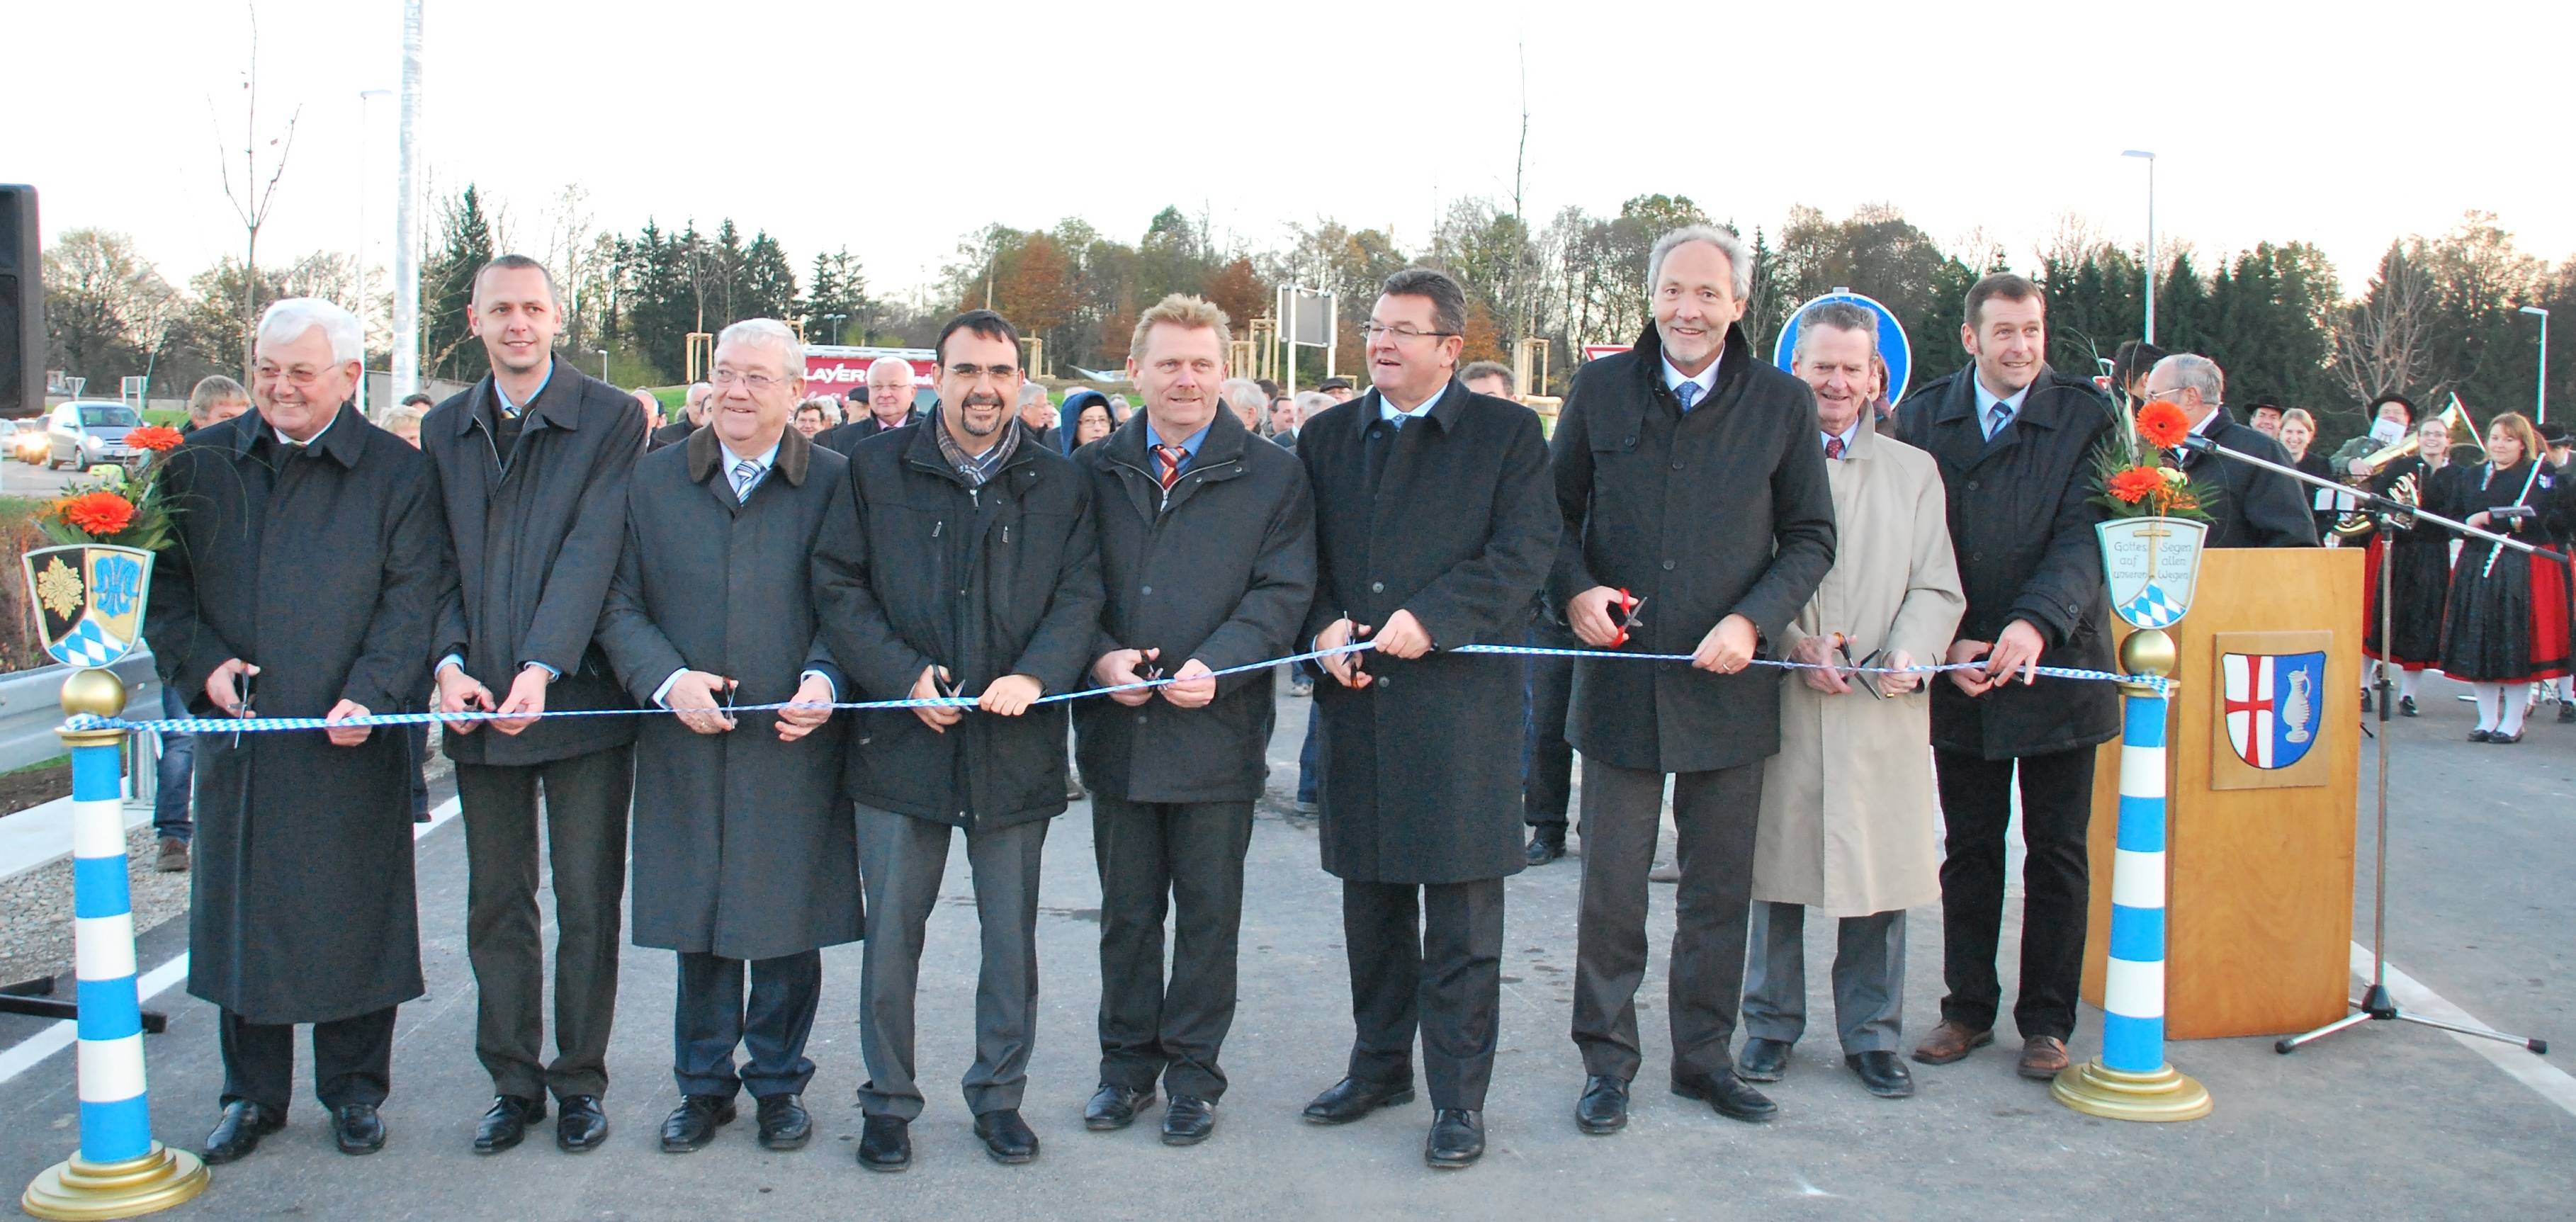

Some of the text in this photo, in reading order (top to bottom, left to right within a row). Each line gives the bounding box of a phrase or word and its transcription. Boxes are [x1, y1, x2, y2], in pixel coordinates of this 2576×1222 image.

[803, 363, 866, 383] LAYER
[2114, 541, 2192, 555] Gottes Segen
[2119, 555, 2186, 567] auf allen
[2158, 571, 2188, 582] Wegen
